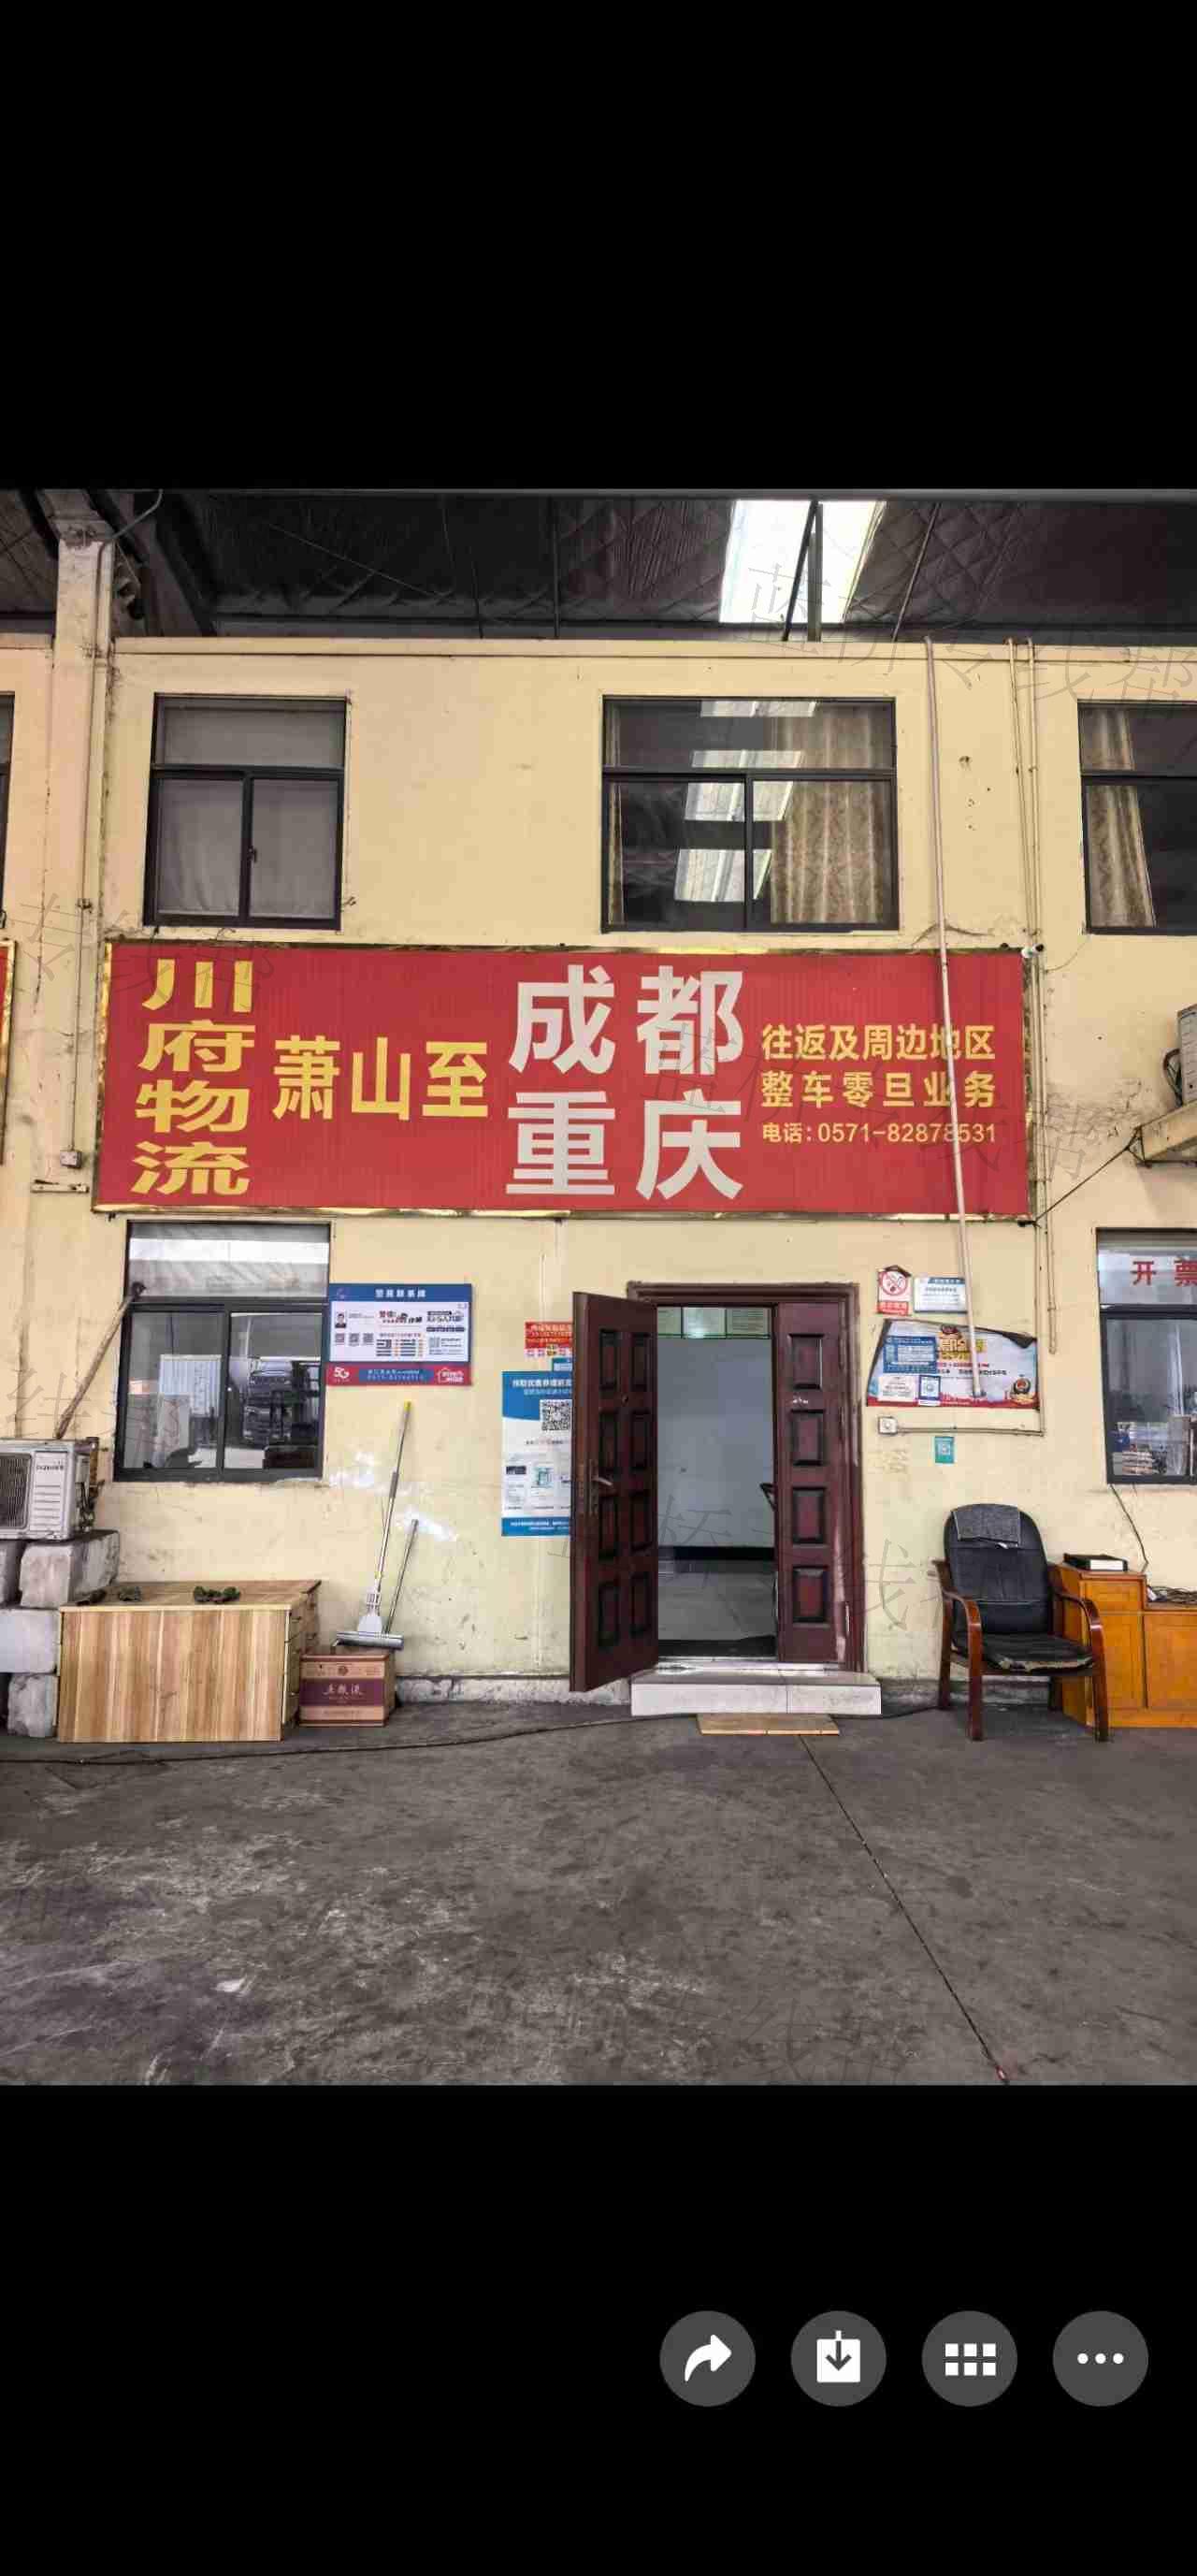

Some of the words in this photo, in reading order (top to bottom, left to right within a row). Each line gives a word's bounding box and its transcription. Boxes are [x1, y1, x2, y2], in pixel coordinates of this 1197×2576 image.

[508, 963, 744, 1076] 成都
[761, 1022, 996, 1061] 往返及周边地区
[131, 958, 256, 1196] 川府物流
[272, 1035, 489, 1122] 萧山至
[760, 1069, 996, 1109] 整车零旦业务
[505, 1088, 744, 1201] 重庆
[1130, 1260, 1197, 1285] 开票
